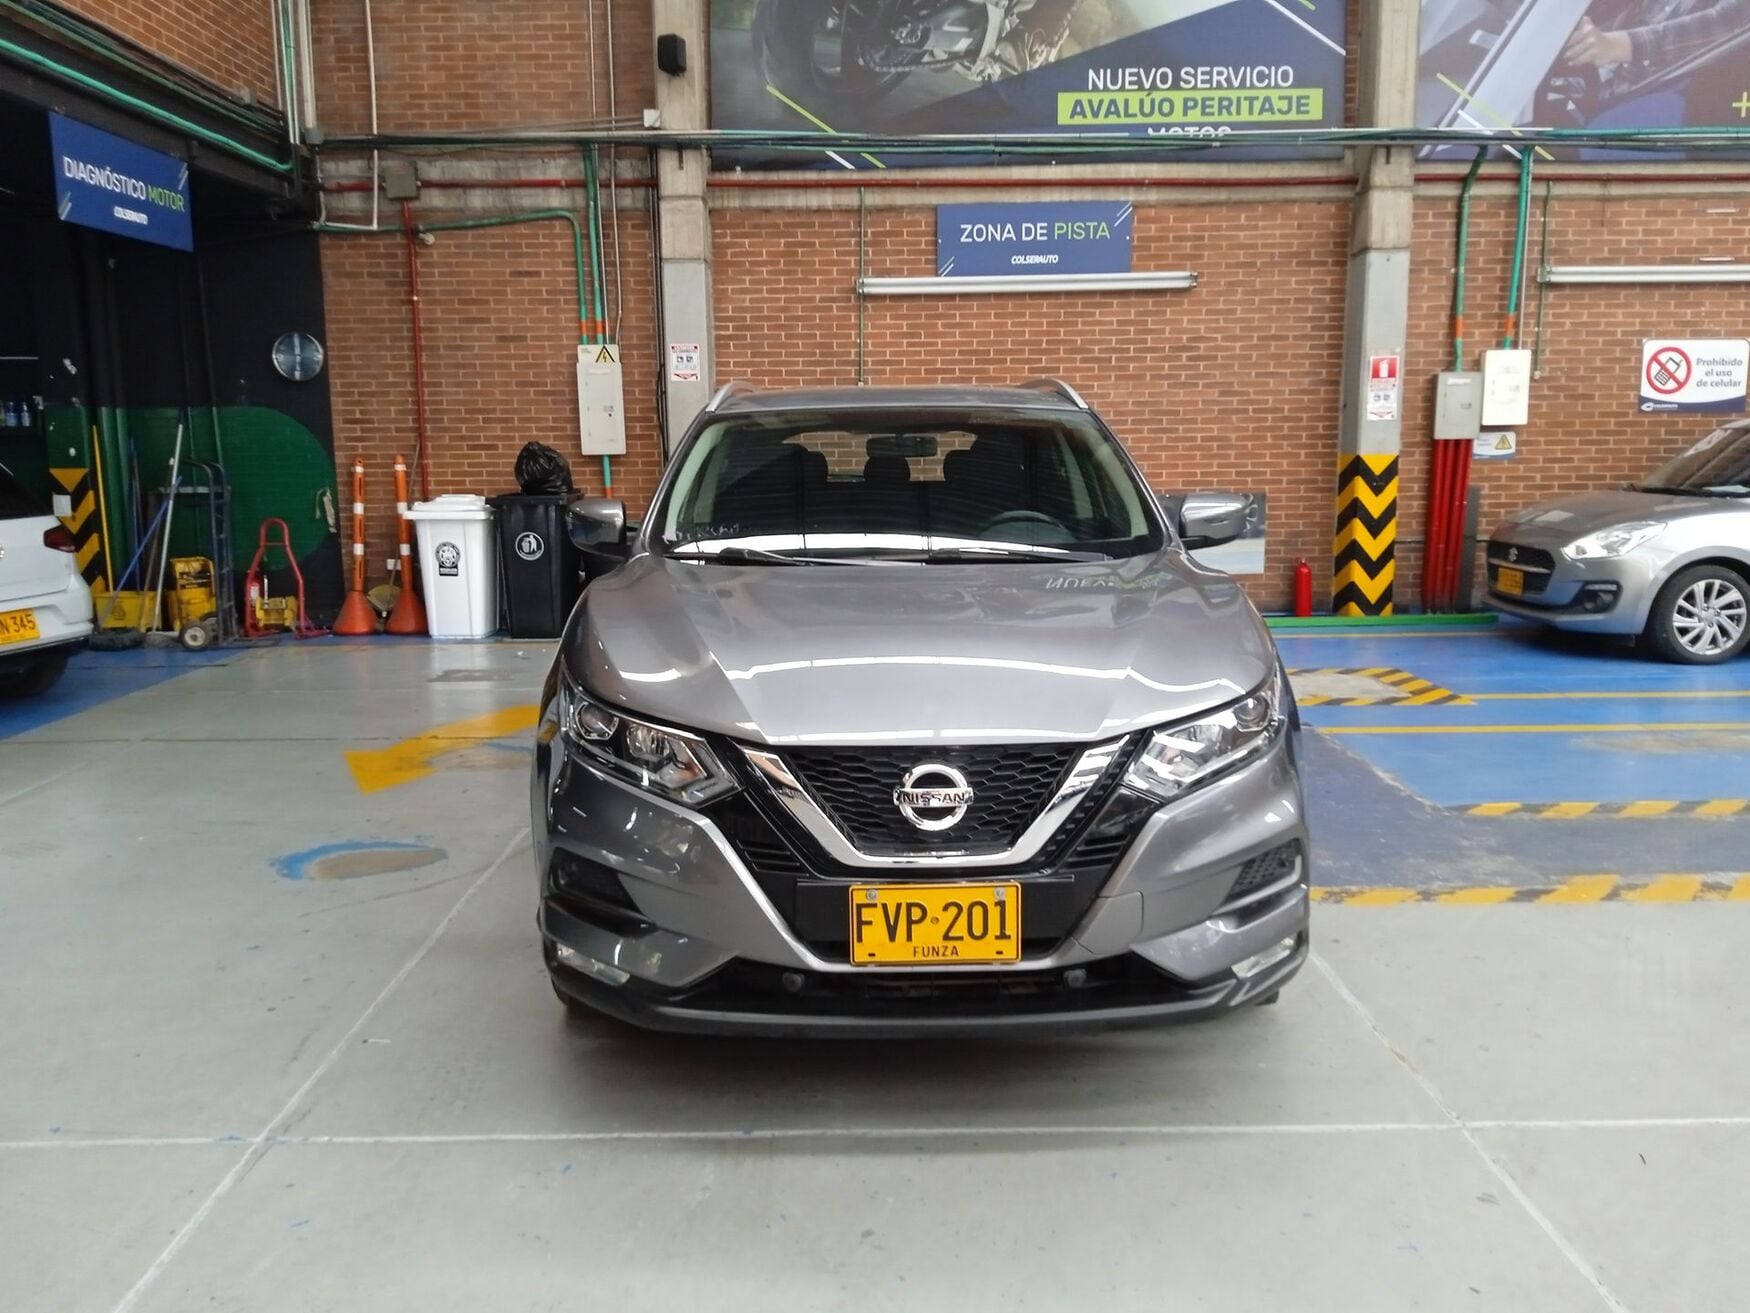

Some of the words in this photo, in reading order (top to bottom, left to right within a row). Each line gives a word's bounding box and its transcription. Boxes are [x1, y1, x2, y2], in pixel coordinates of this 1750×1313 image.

[1088, 67, 1173, 91] NUEVO
[1179, 65, 1294, 89] SERVICIO
[1069, 93, 1175, 119] AVALÚO
[1182, 94, 1311, 118] PERITAJE
[63, 155, 146, 201] DIAGNÓSTICO
[148, 185, 185, 212] MOTOR
[960, 223, 1016, 243] ZONA
[1022, 222, 1048, 242] DE
[1054, 221, 1111, 241] PISTA
[1696, 357, 1743, 367] Prohibido
[1705, 368, 1714, 377] el
[1715, 369, 1733, 377] uso
[1696, 378, 1709, 387] de
[1710, 378, 1741, 388] celular
[10, 613, 36, 633] 345
[902, 791, 965, 805] NISSAN
[913, 945, 960, 958] FUNZA
